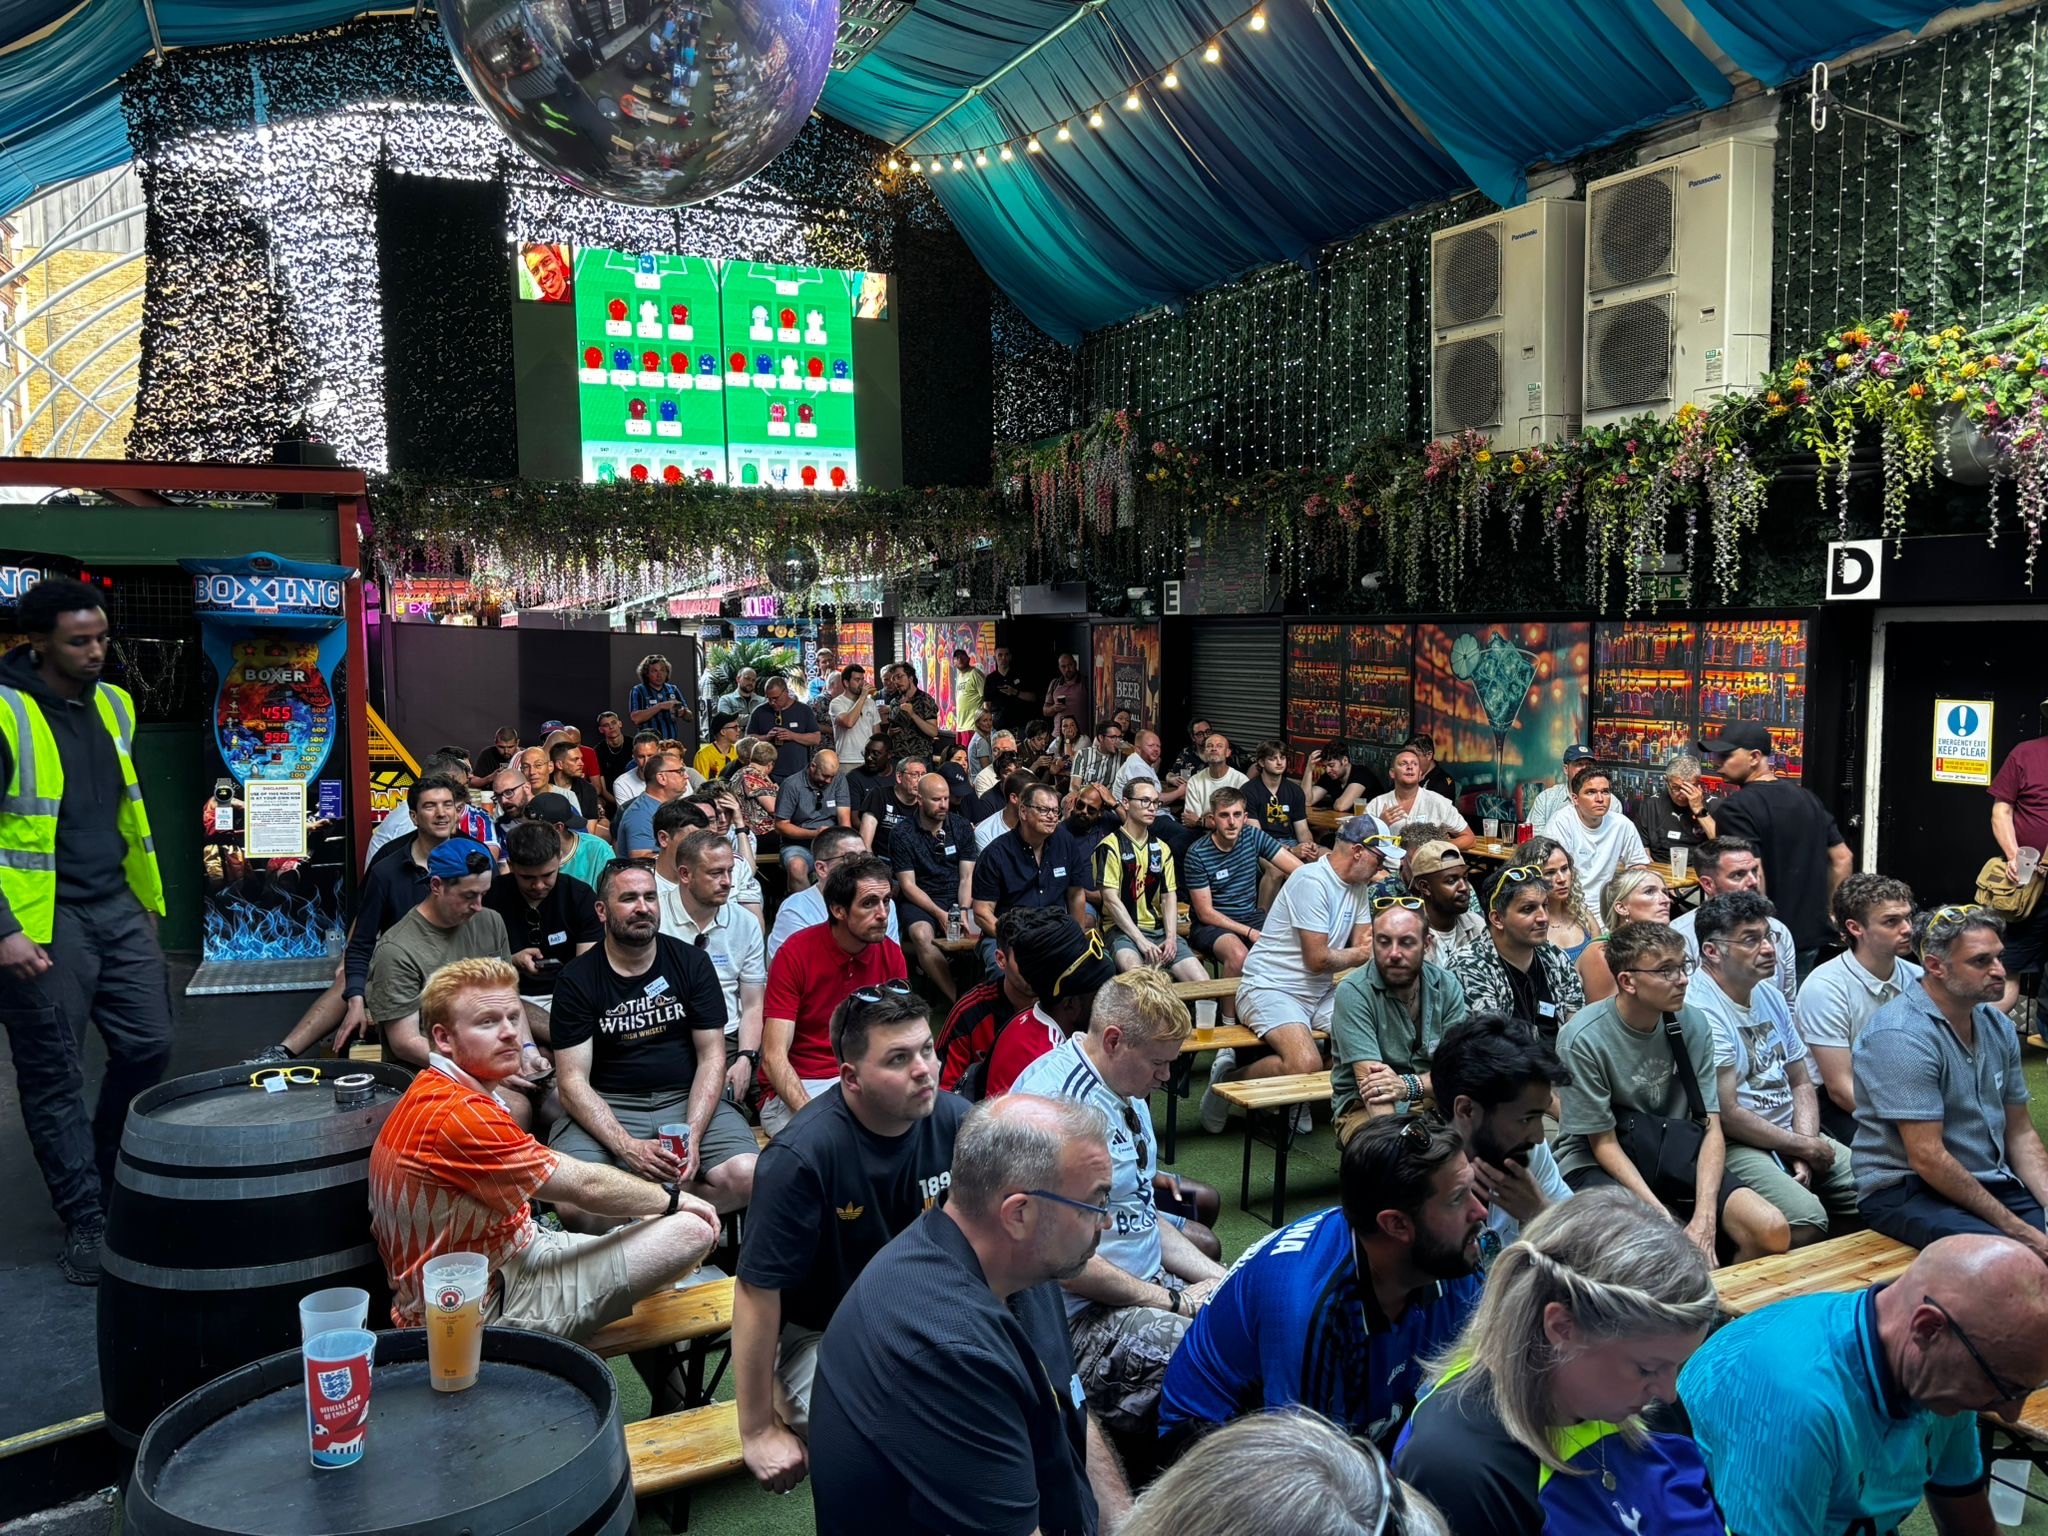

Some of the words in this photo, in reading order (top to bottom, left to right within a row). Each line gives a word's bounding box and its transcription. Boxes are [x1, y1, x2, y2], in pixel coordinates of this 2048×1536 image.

[1688, 173, 1722, 188] Panasonic
[1511, 229, 1538, 241] Panasonic
[1831, 547, 1874, 595] D
[194, 574, 340, 608] BOXING
[1165, 583, 1178, 612] E
[245, 667, 305, 683] BOXER
[1116, 681, 1140, 700] BEER
[1124, 700, 1131, 709] OF
[262, 707, 291, 719] 455
[264, 732, 289, 743] 999
[1938, 738, 1973, 747] EMERGENCY
[1938, 746, 1958, 755] KEEP
[1960, 747, 1986, 757] CLEAR
[626, 996, 656, 1014] THE
[599, 1002, 687, 1034] WHISTLER
[638, 1025, 667, 1038] WHISKEY
[919, 1170, 953, 1198] 189
[320, 1402, 346, 1414] OFFICIAL
[346, 1394, 361, 1406] BEER
[332, 1403, 359, 1419] ENGLAND
